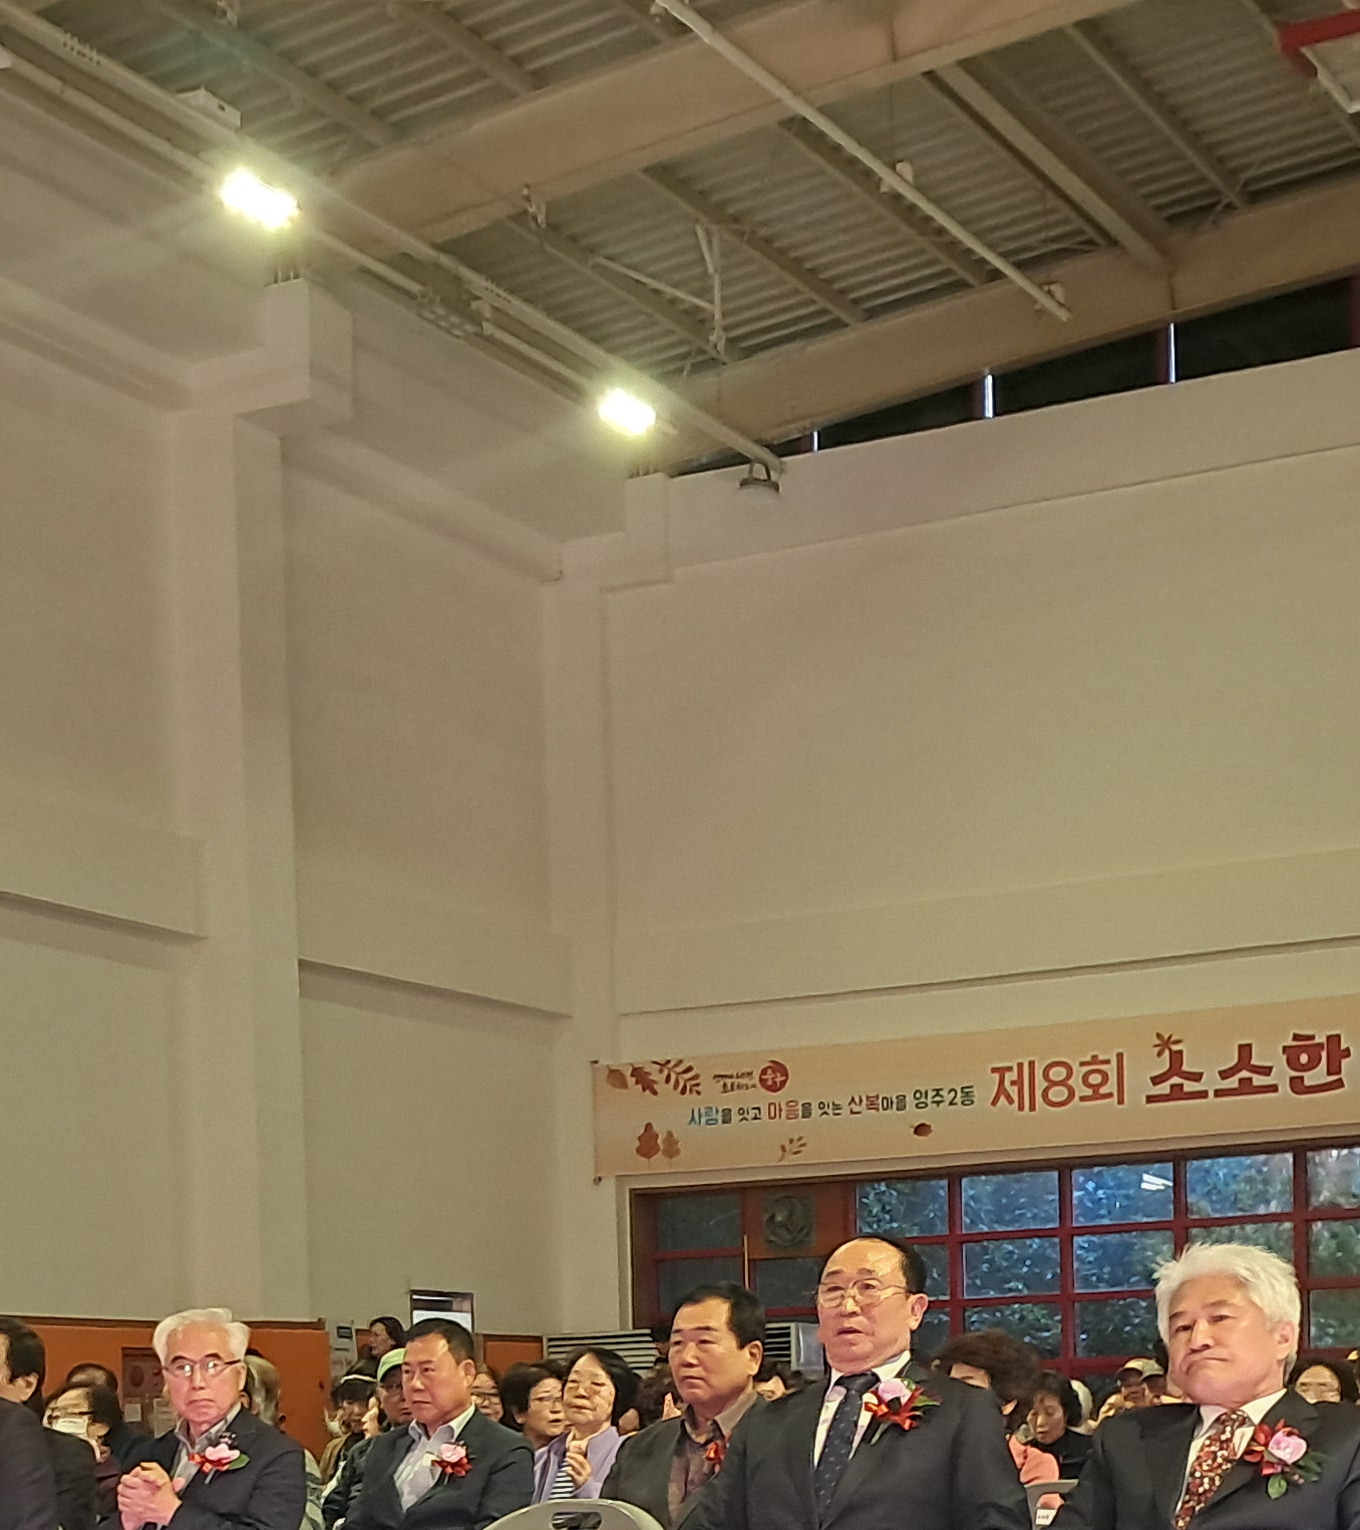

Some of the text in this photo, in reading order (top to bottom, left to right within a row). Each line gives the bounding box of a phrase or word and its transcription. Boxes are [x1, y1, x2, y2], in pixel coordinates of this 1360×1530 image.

[989, 1053, 1125, 1112] 제8회
[1145, 1032, 1351, 1105] 소소한
[689, 1106, 732, 1126] 사람을
[737, 1106, 762, 1122] 잇고
[767, 1100, 812, 1120] 마음을
[818, 1101, 843, 1117] 잇는
[913, 1085, 975, 1109] 영주2동
